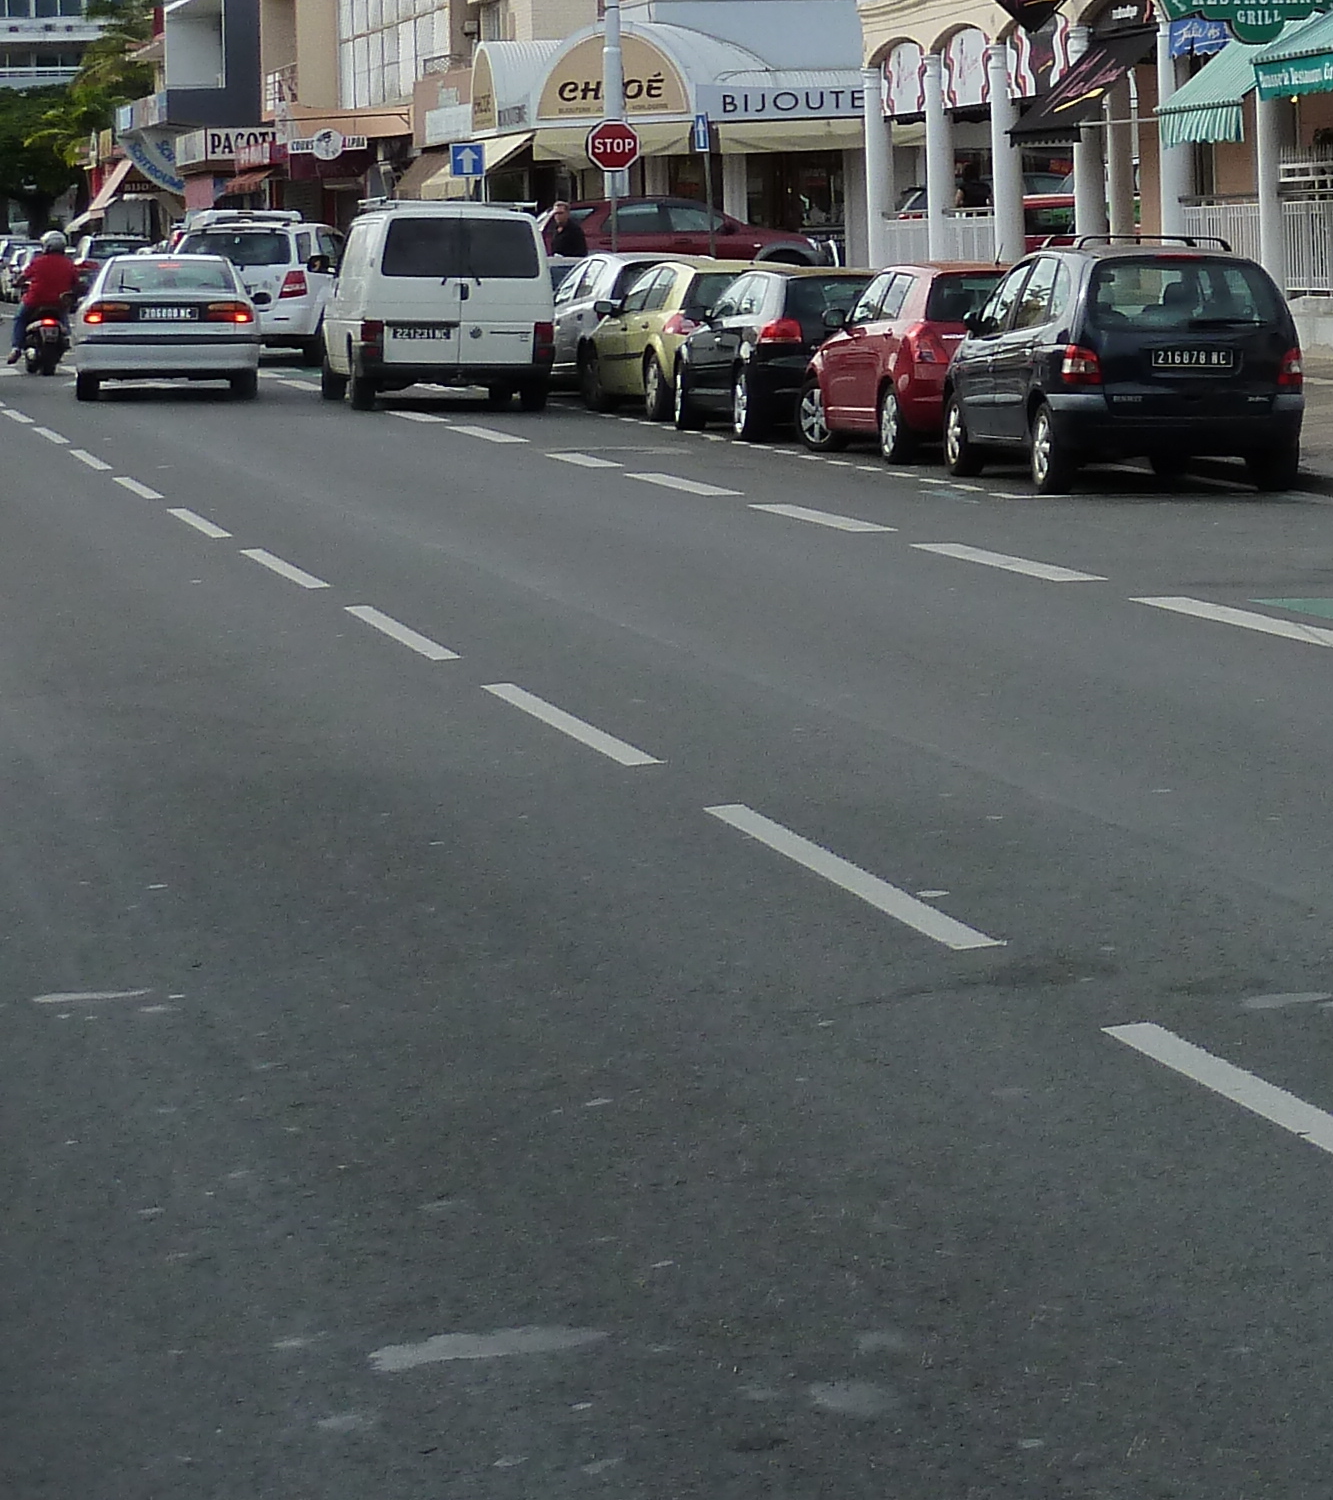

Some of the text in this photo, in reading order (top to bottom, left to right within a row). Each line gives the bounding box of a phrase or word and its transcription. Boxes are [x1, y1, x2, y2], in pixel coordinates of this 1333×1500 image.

[1236, 9, 1282, 26] GRILL
[558, 71, 665, 102] CHOÉ
[594, 138, 635, 153] STOP
[1211, 352, 1227, 365] NC
